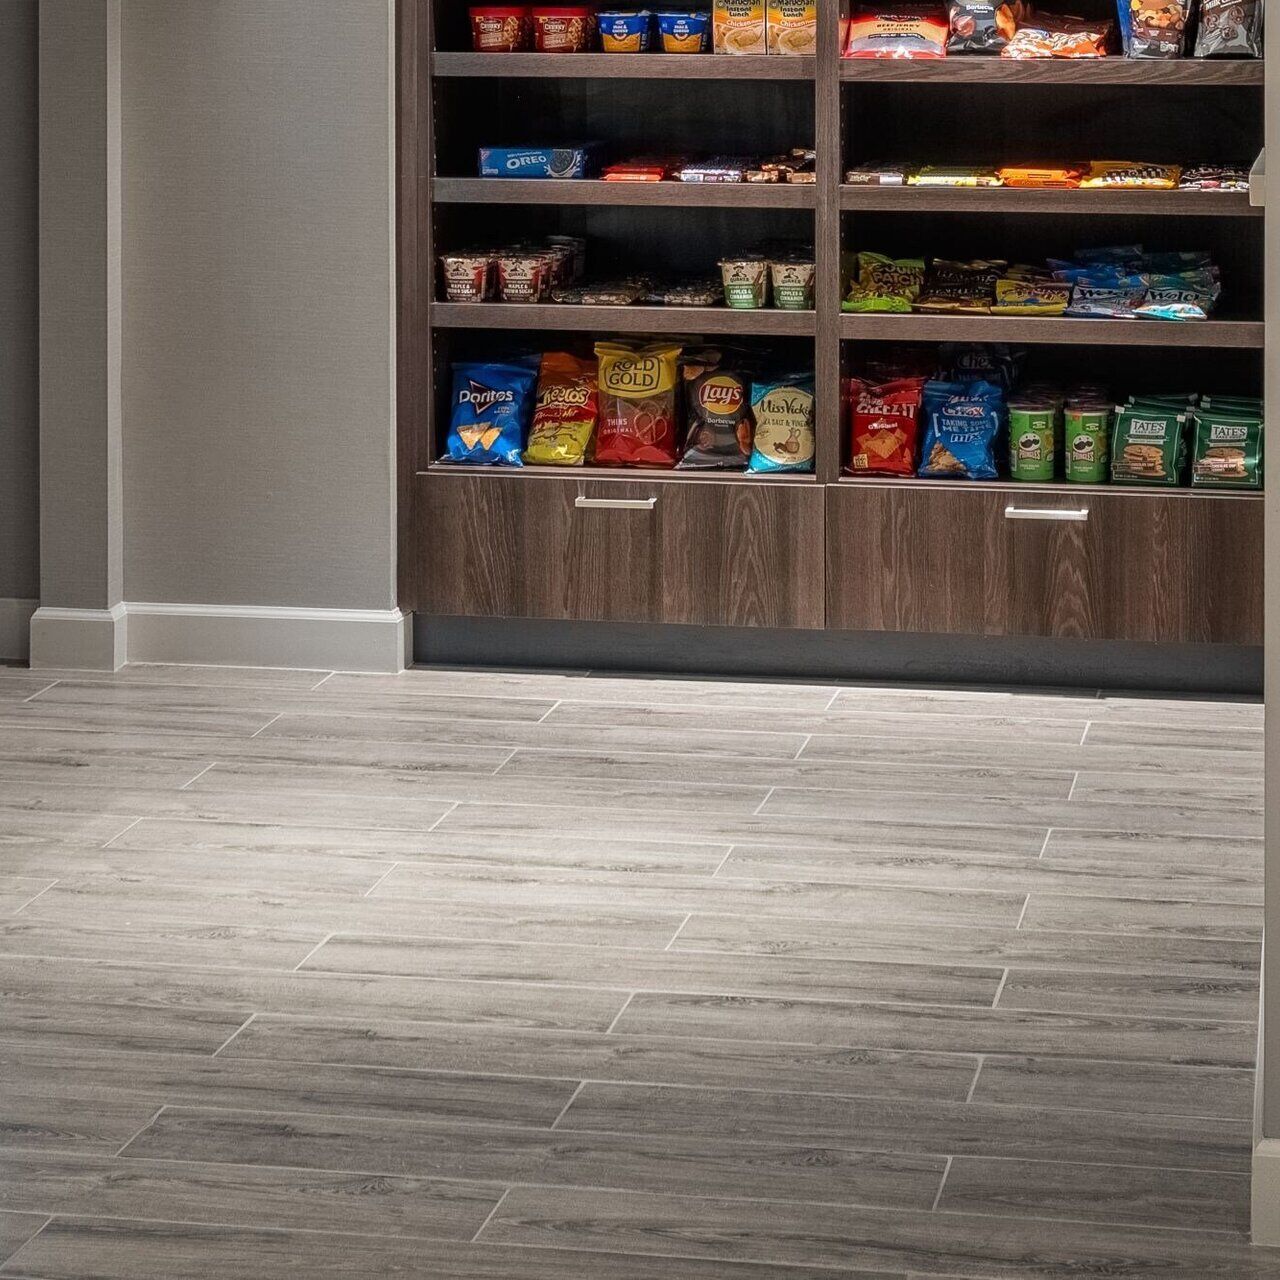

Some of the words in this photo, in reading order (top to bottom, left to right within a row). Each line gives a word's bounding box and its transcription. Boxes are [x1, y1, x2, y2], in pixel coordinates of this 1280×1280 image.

[506, 155, 547, 169] OREO
[873, 272, 925, 286] PATCH
[611, 359, 655, 372] ROLD
[609, 372, 655, 387] GOLD
[459, 390, 514, 404] Doritos
[760, 400, 784, 414] Miss
[607, 418, 628, 426] THINS
[1133, 421, 1165, 431] TATE'S
[1213, 426, 1246, 437] TATE'S
